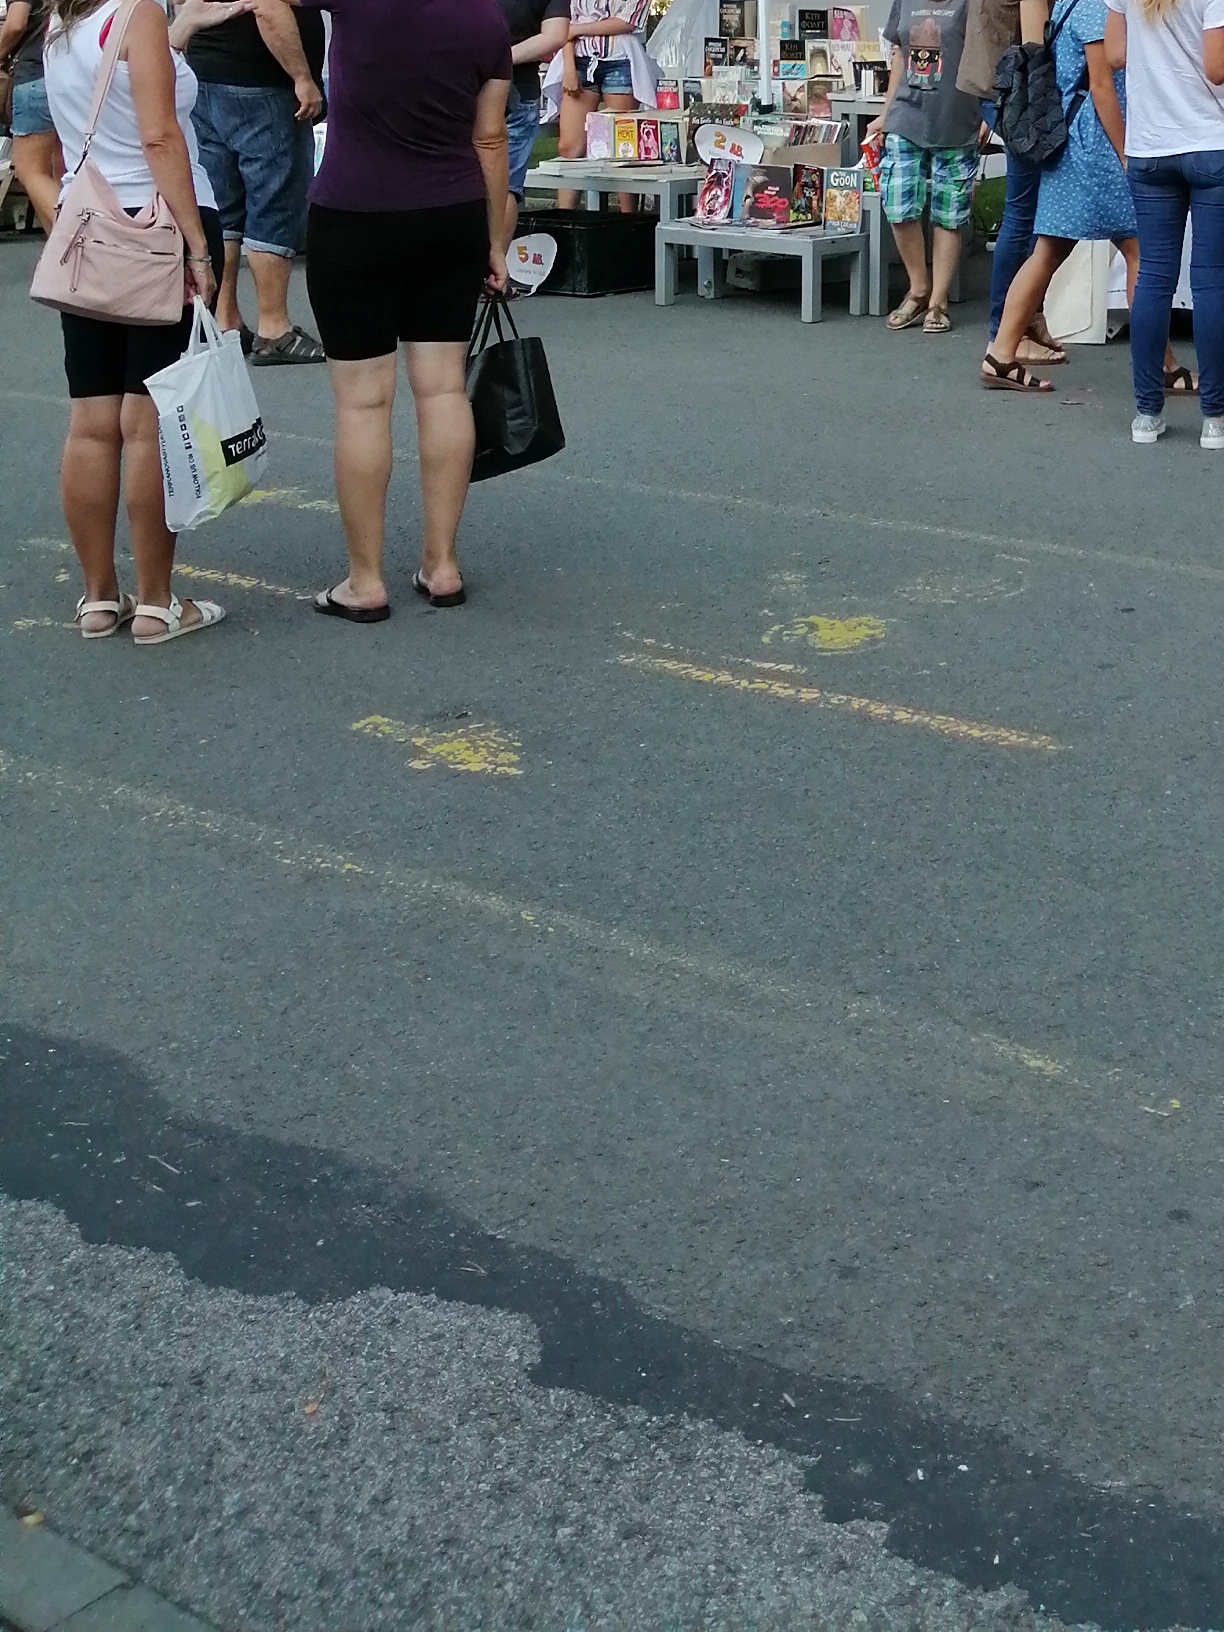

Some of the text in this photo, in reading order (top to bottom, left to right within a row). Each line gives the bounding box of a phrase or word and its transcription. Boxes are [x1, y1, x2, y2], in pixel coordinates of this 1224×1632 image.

[713, 131, 727, 151] 2
[830, 171, 858, 187] GOON
[516, 245, 529, 263] 5
